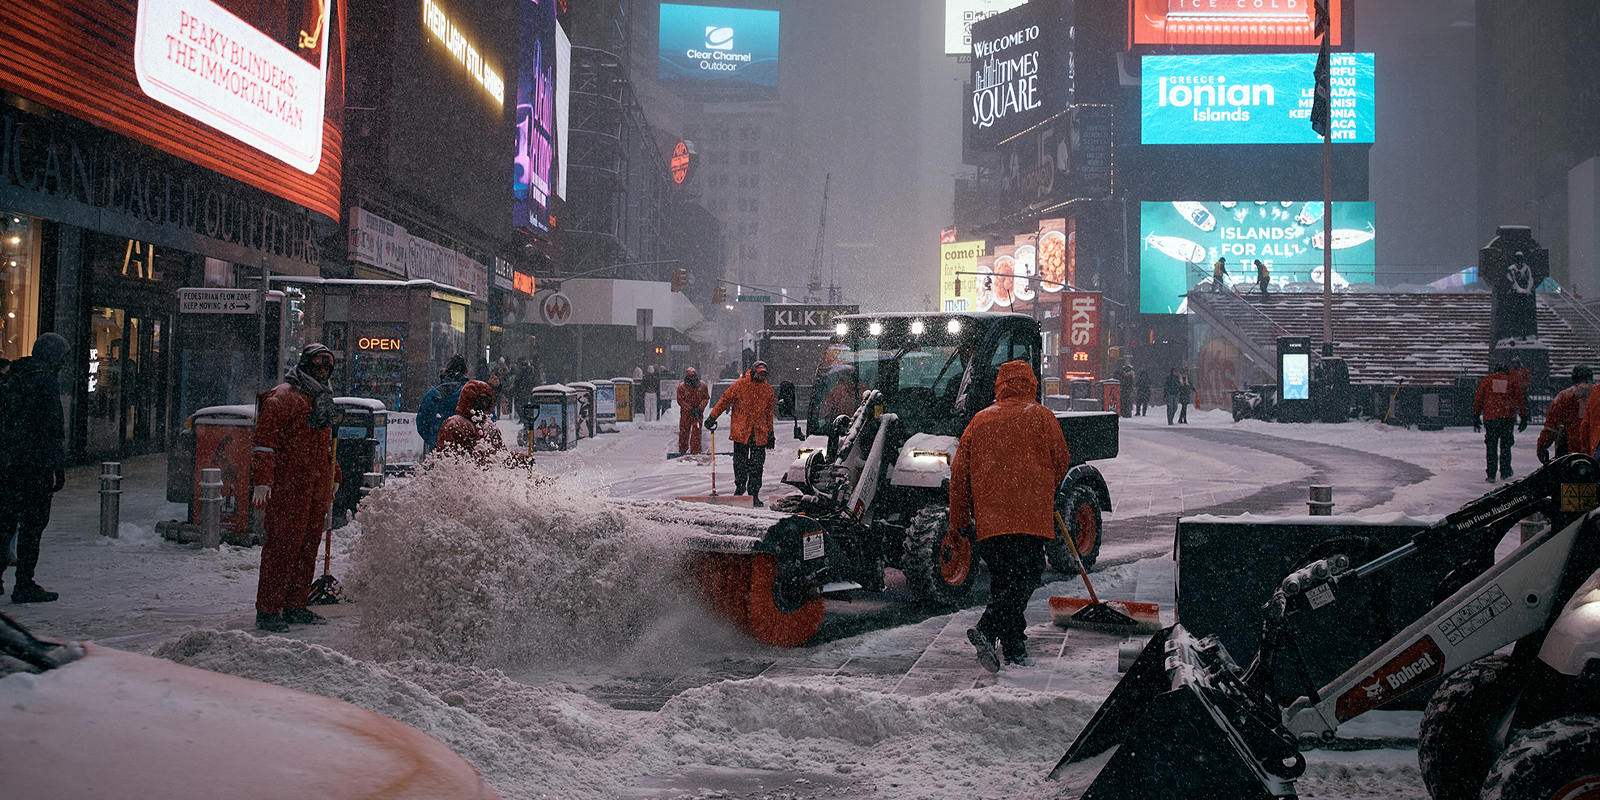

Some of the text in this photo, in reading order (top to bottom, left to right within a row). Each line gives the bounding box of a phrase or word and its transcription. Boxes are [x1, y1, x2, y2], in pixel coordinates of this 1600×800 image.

[1237, 0, 1297, 8] COLD
[424, 0, 447, 44] THEIR
[446, 20, 467, 65] LIGHT
[466, 44, 484, 85] STILL
[974, 25, 1040, 59] WELCOME TO
[179, 10, 299, 100] PEAKY BLINDERS:
[686, 49, 751, 62] Clear Channel
[1330, 57, 1356, 66] NTE
[700, 60, 737, 72] Outdoor
[1000, 50, 1039, 84] TIMES
[1330, 67, 1356, 76] RFU
[165, 34, 304, 130] THE IMMORTAL MAN
[1169, 75, 1214, 84] GREECE
[1159, 75, 1274, 106] Ionian
[1301, 88, 1356, 98] LEADA
[1298, 99, 1356, 108] MENISI
[1193, 107, 1250, 122] Islands
[1289, 109, 1356, 118] KEFNIA
[1317, 130, 1356, 140] NTE
[103, 151, 199, 232] EAGLE
[205, 189, 320, 266] OUTFITTERS
[1220, 227, 1295, 240] ISLANDS
[945, 249, 974, 260] come
[1222, 243, 1293, 256] FOR ALL
[122, 239, 162, 281] AE
[944, 262, 966, 276] for the
[944, 279, 967, 294] perct
[1224, 275, 1290, 285] SENES
[183, 292, 251, 301] PEDESTRIAN FLOW ZONE
[183, 302, 222, 310] KEEP MOVING
[1071, 296, 1096, 346] tkts
[358, 337, 401, 350] OPEN
[1456, 494, 1527, 531] High Flow Hydraulics
[1386, 652, 1435, 691] Bobcat
